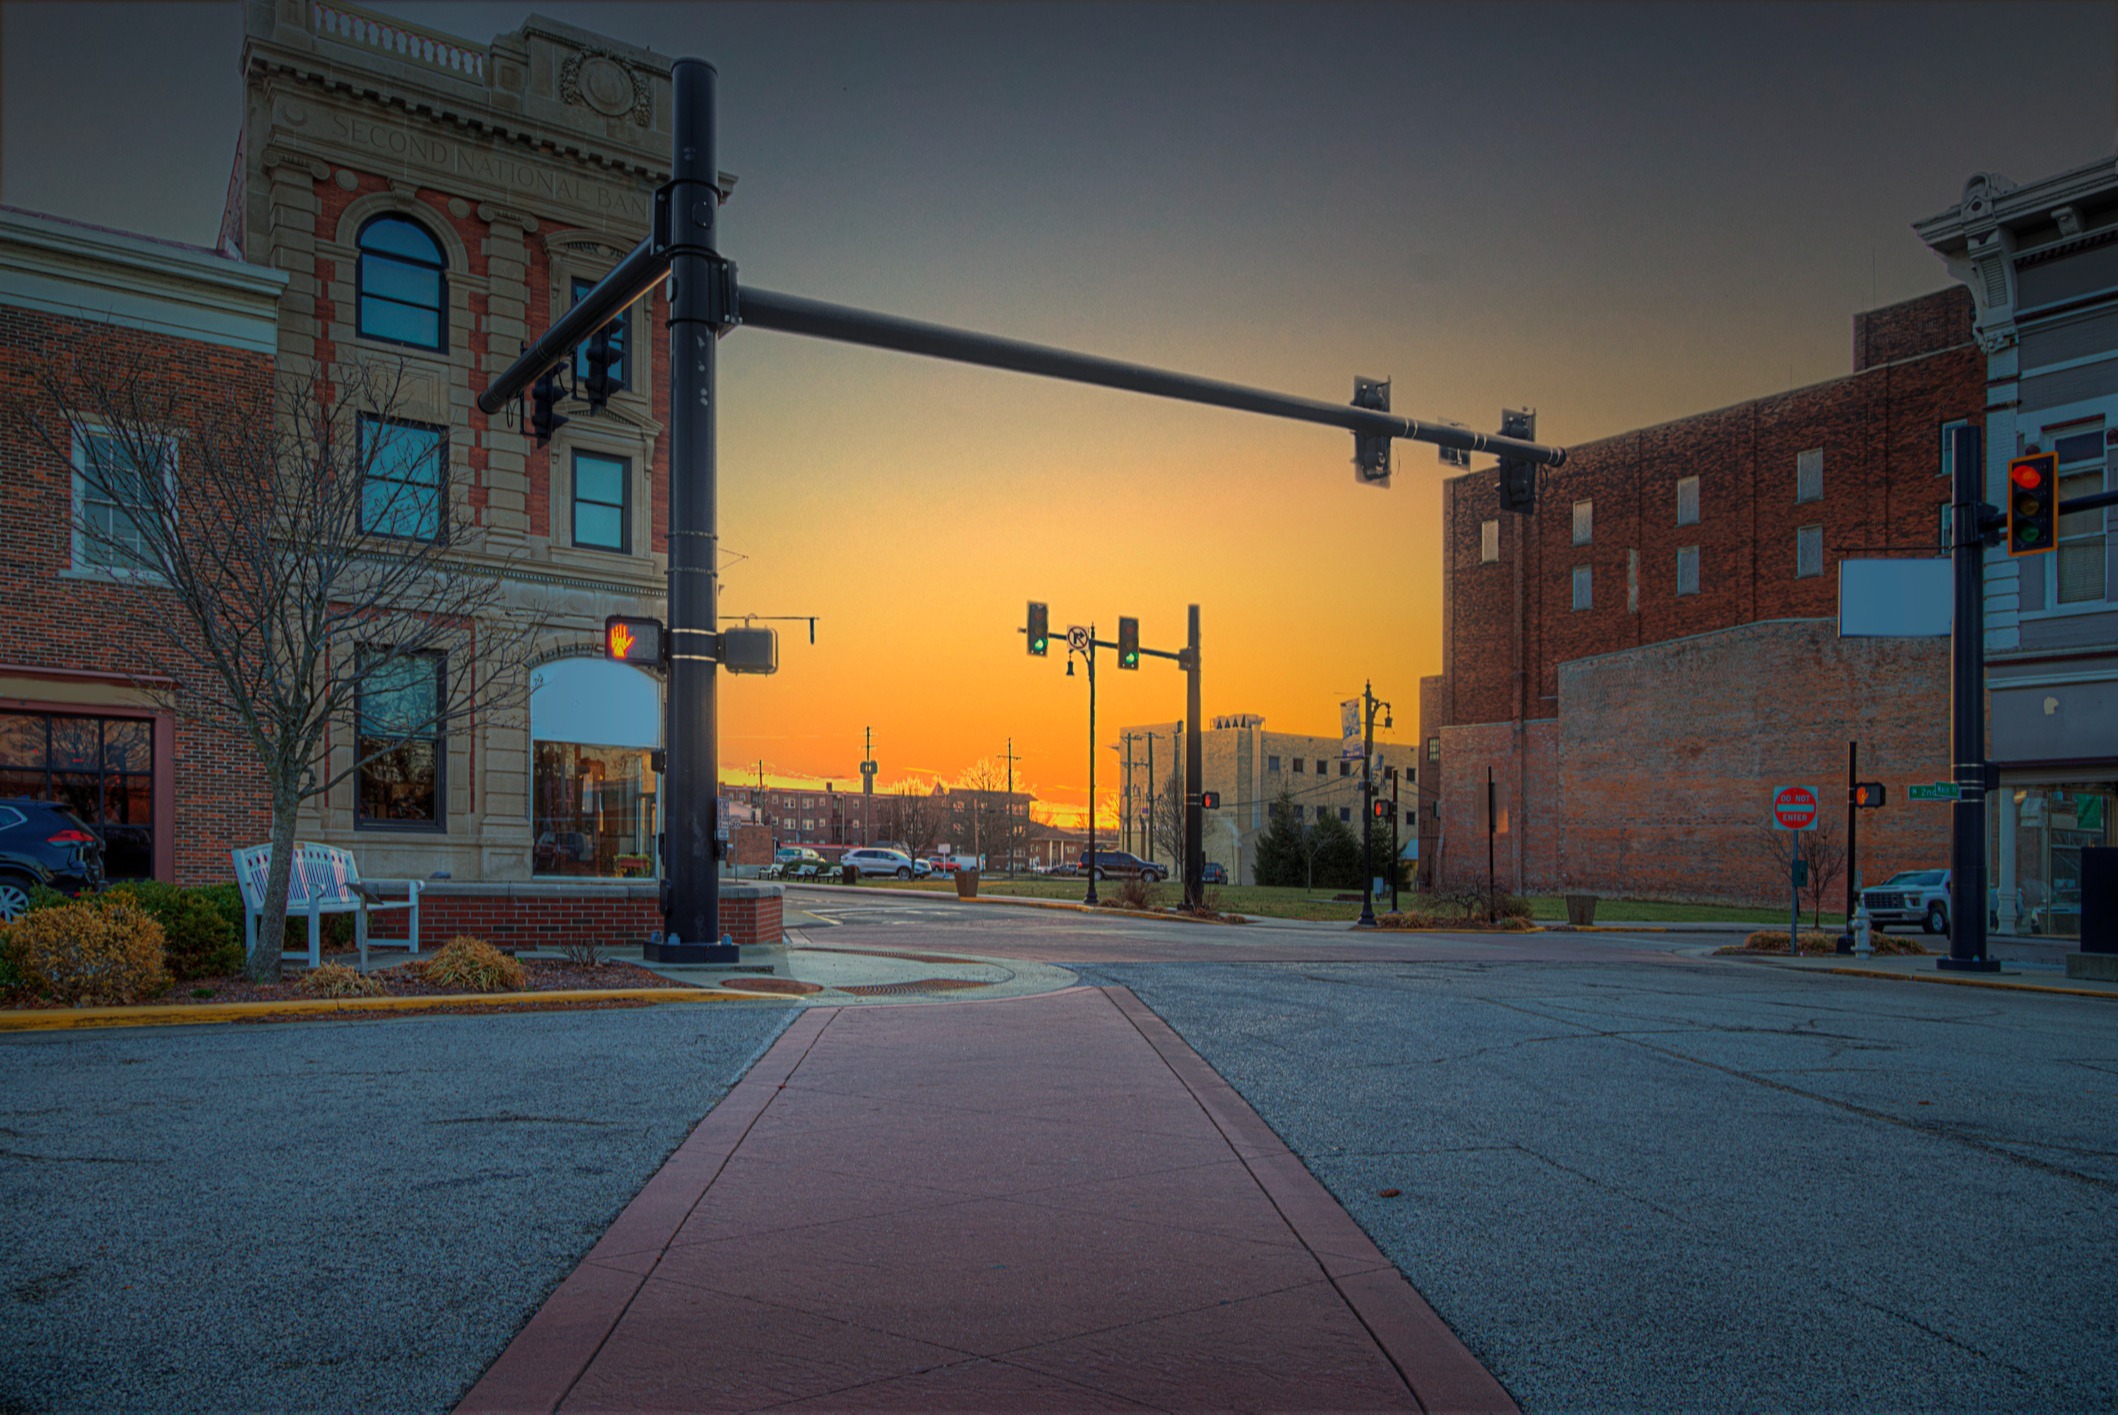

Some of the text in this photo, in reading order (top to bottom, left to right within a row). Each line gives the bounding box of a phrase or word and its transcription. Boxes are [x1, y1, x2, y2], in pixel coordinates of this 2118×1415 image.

[331, 113, 648, 218] SECOND NATIONAL BAN
[1780, 794, 1810, 803] DO NOT
[1782, 813, 1807, 822] ENTER
